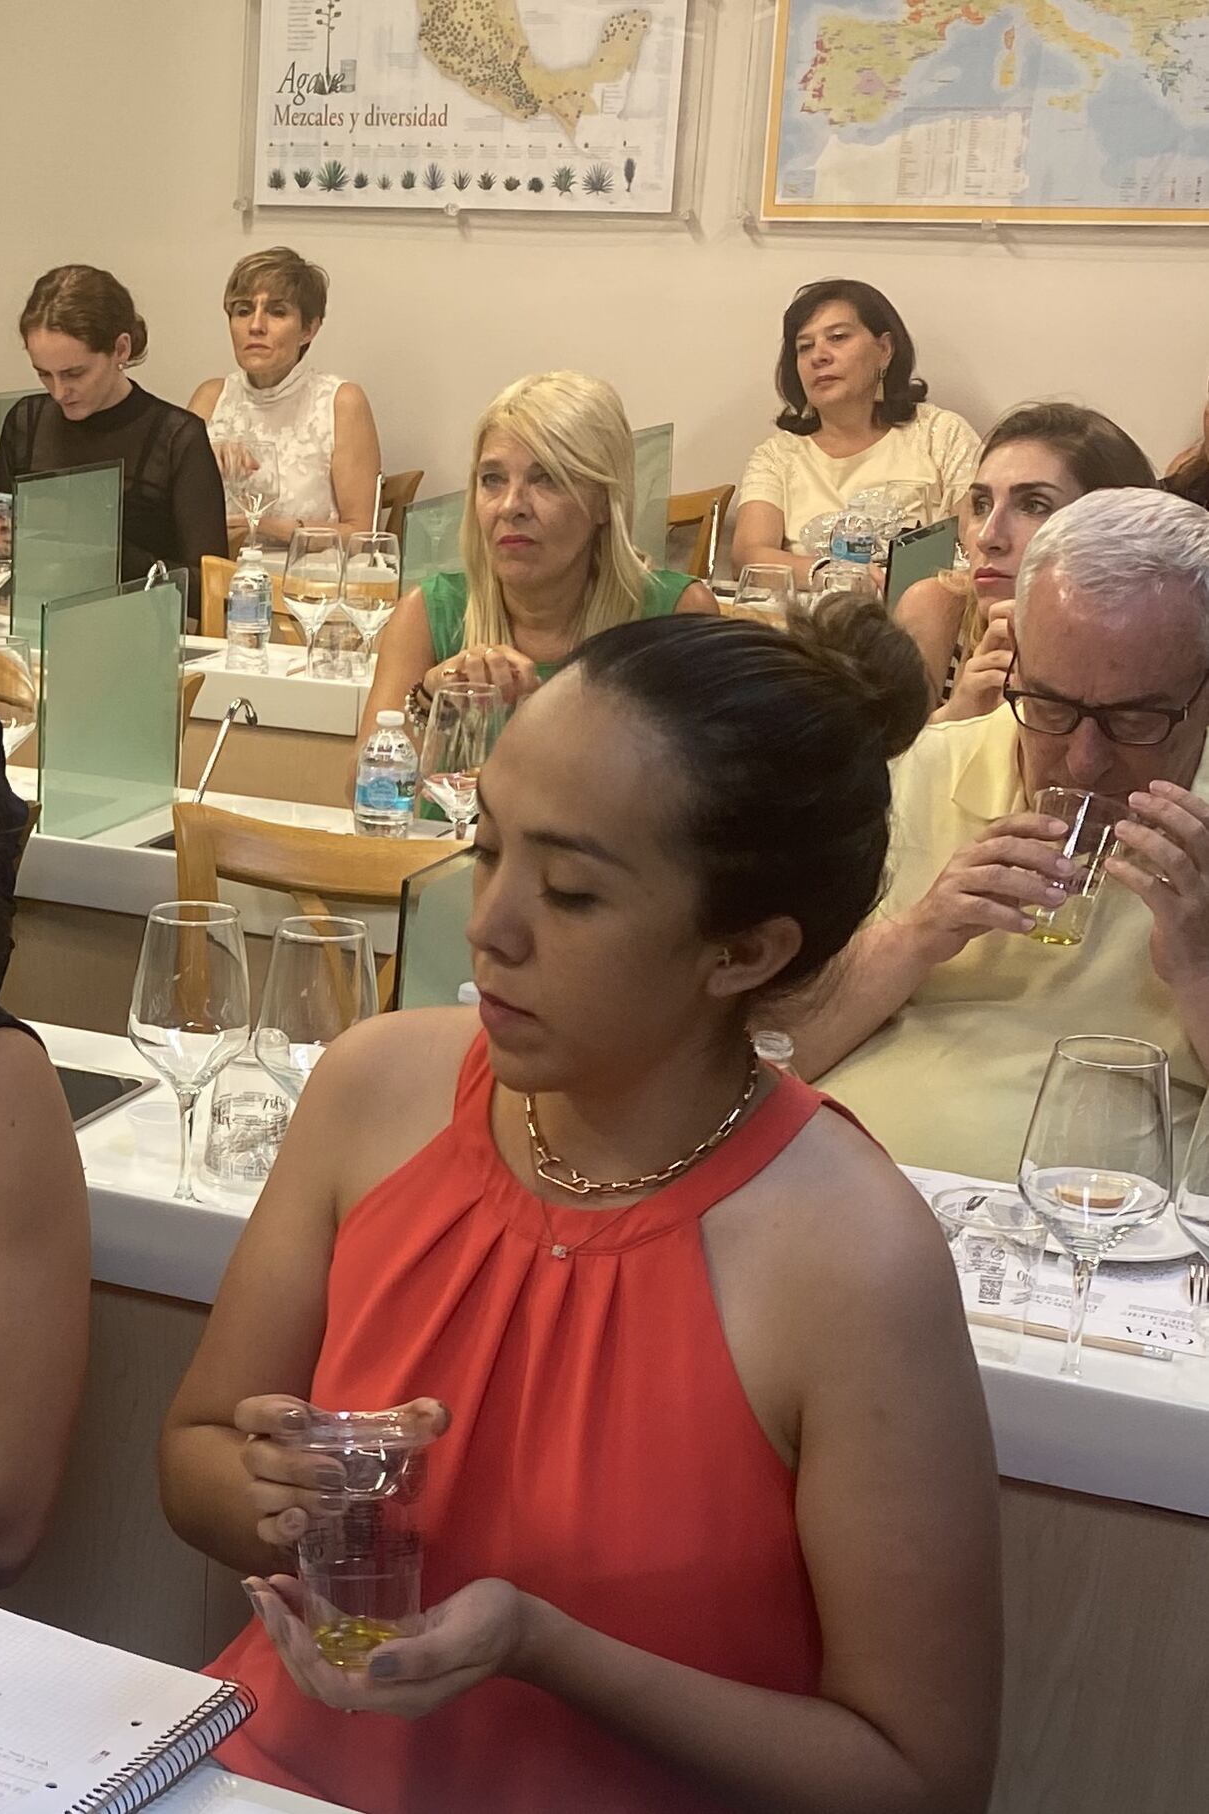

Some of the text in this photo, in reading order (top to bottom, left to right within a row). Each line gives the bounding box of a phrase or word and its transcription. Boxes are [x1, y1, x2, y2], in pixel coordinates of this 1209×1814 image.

[276, 61, 346, 106] Agave
[273, 104, 344, 127] Mezcales
[349, 112, 361, 134] y
[364, 103, 449, 127] diversidad
